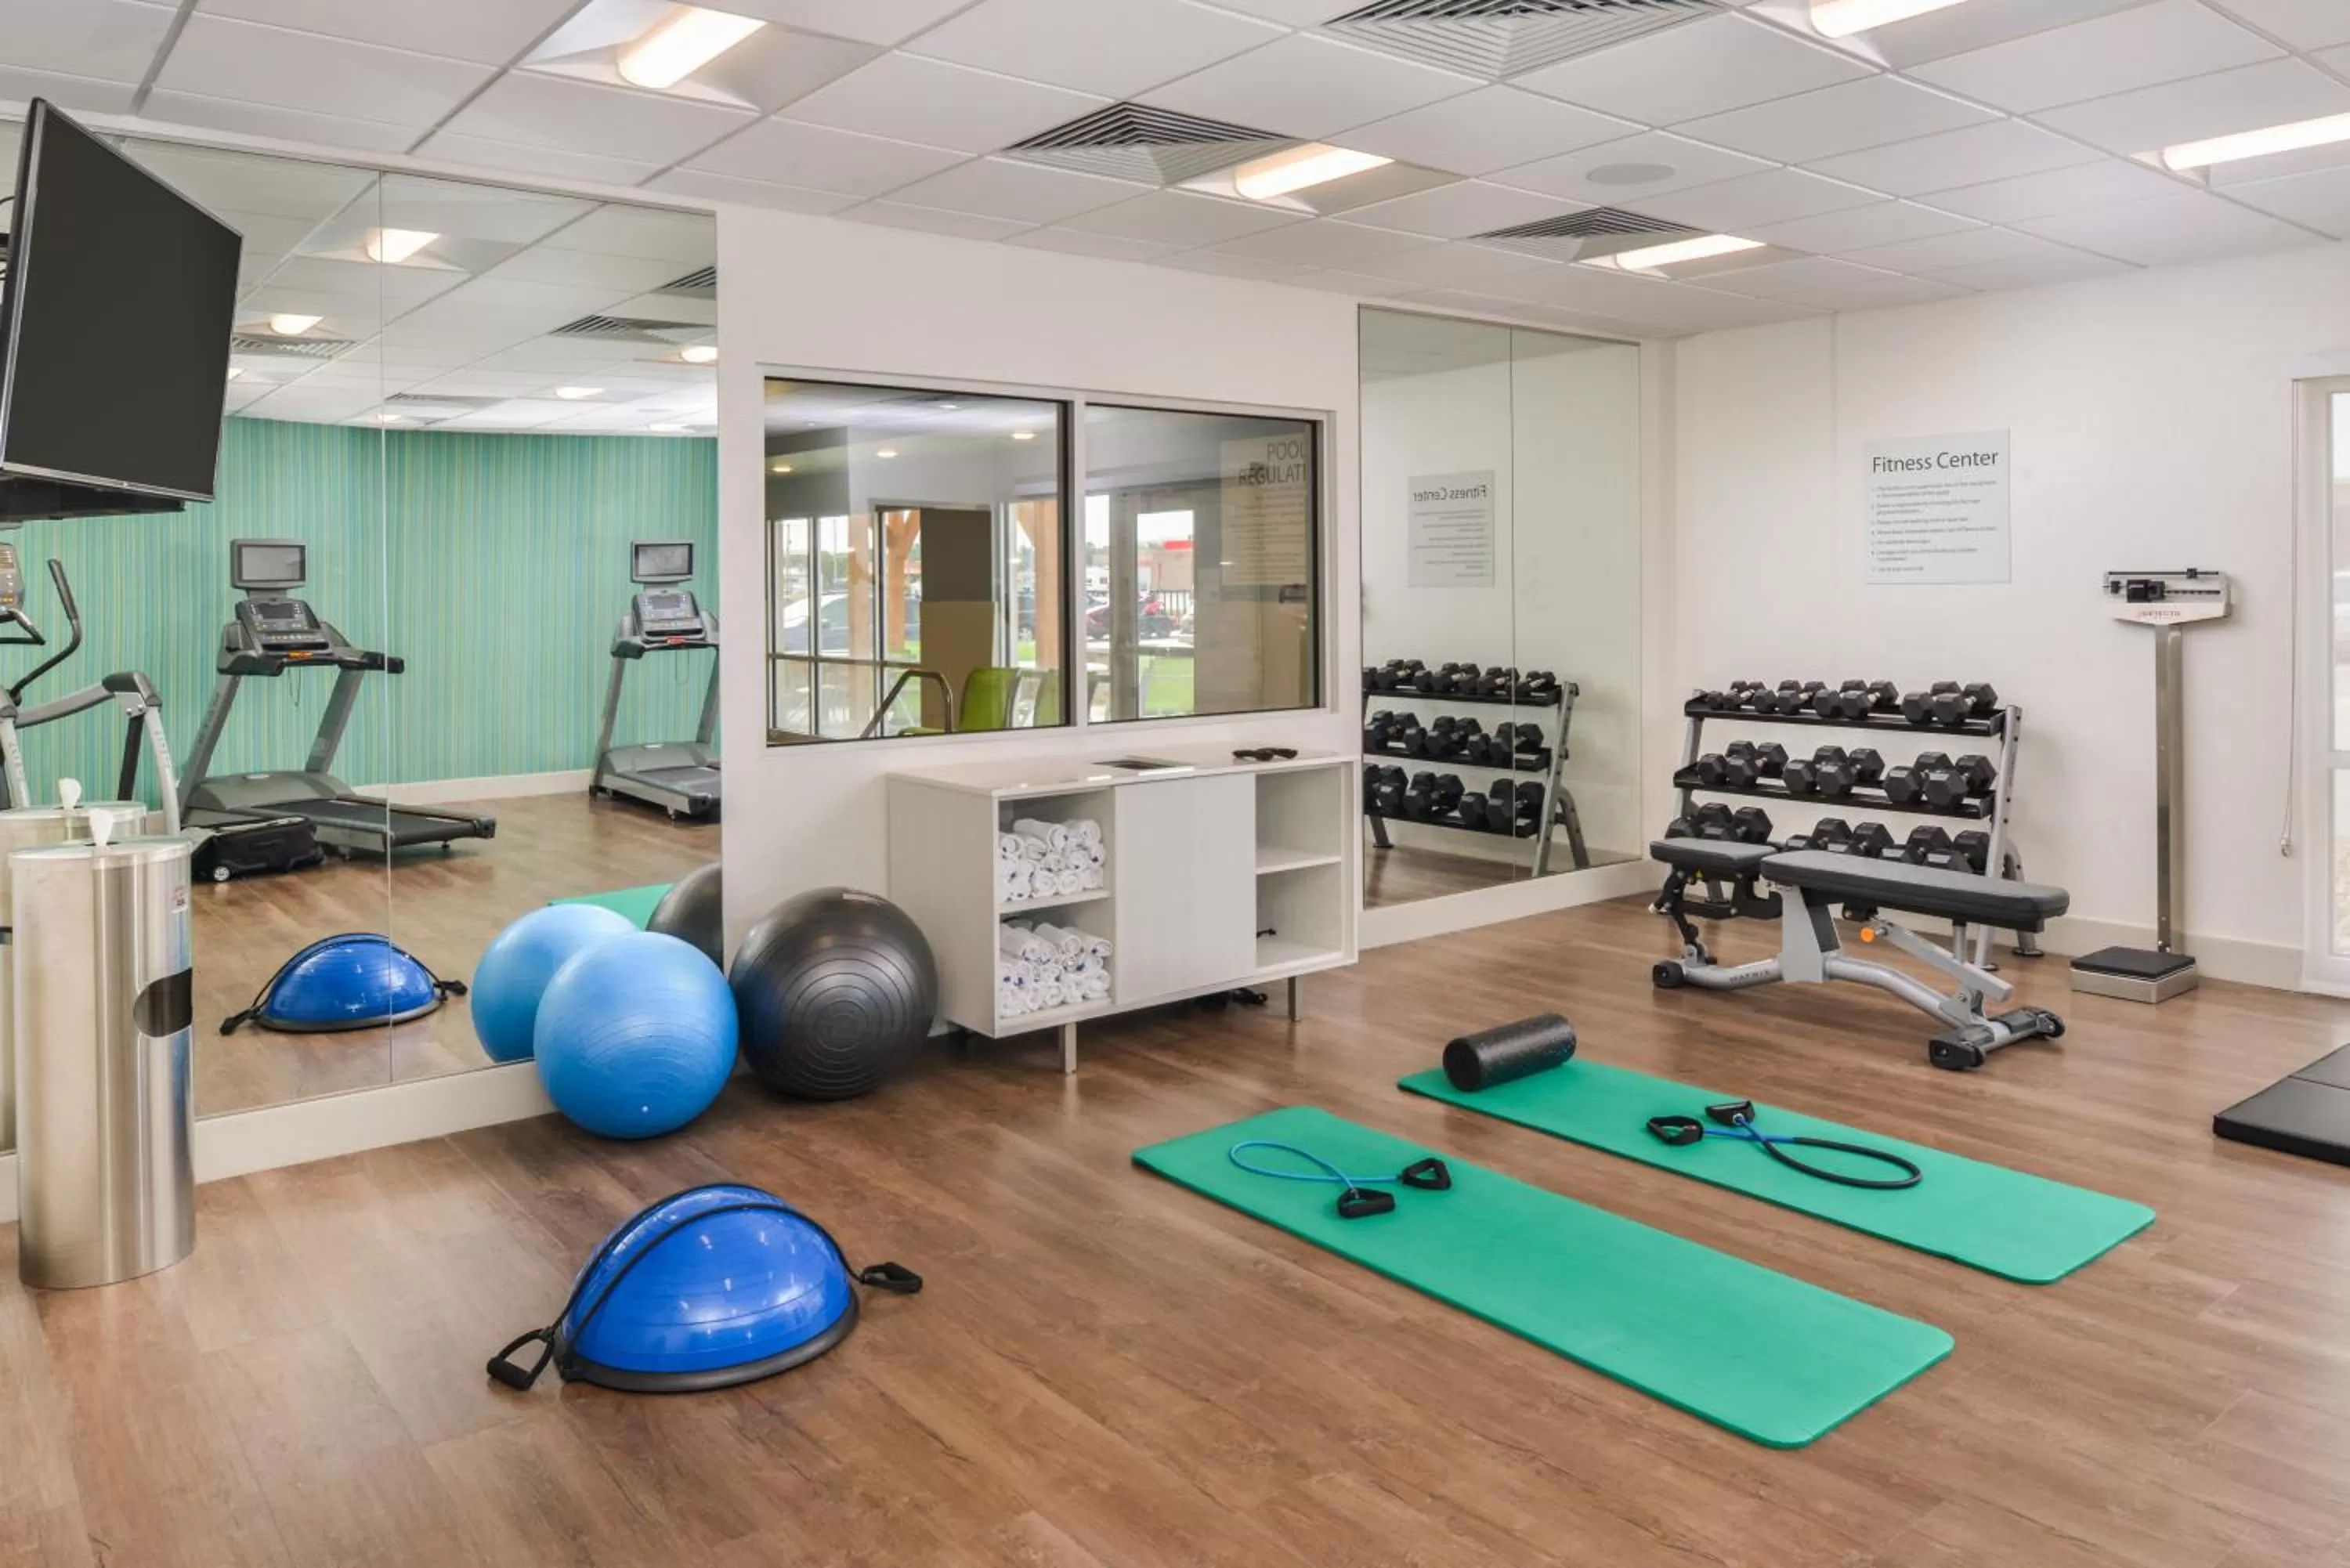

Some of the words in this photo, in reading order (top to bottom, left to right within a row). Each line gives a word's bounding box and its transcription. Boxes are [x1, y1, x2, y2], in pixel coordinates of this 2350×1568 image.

[1267, 439, 1306, 461] POOL
[1873, 456, 1932, 474] Fitness
[1936, 451, 1999, 469] Center
